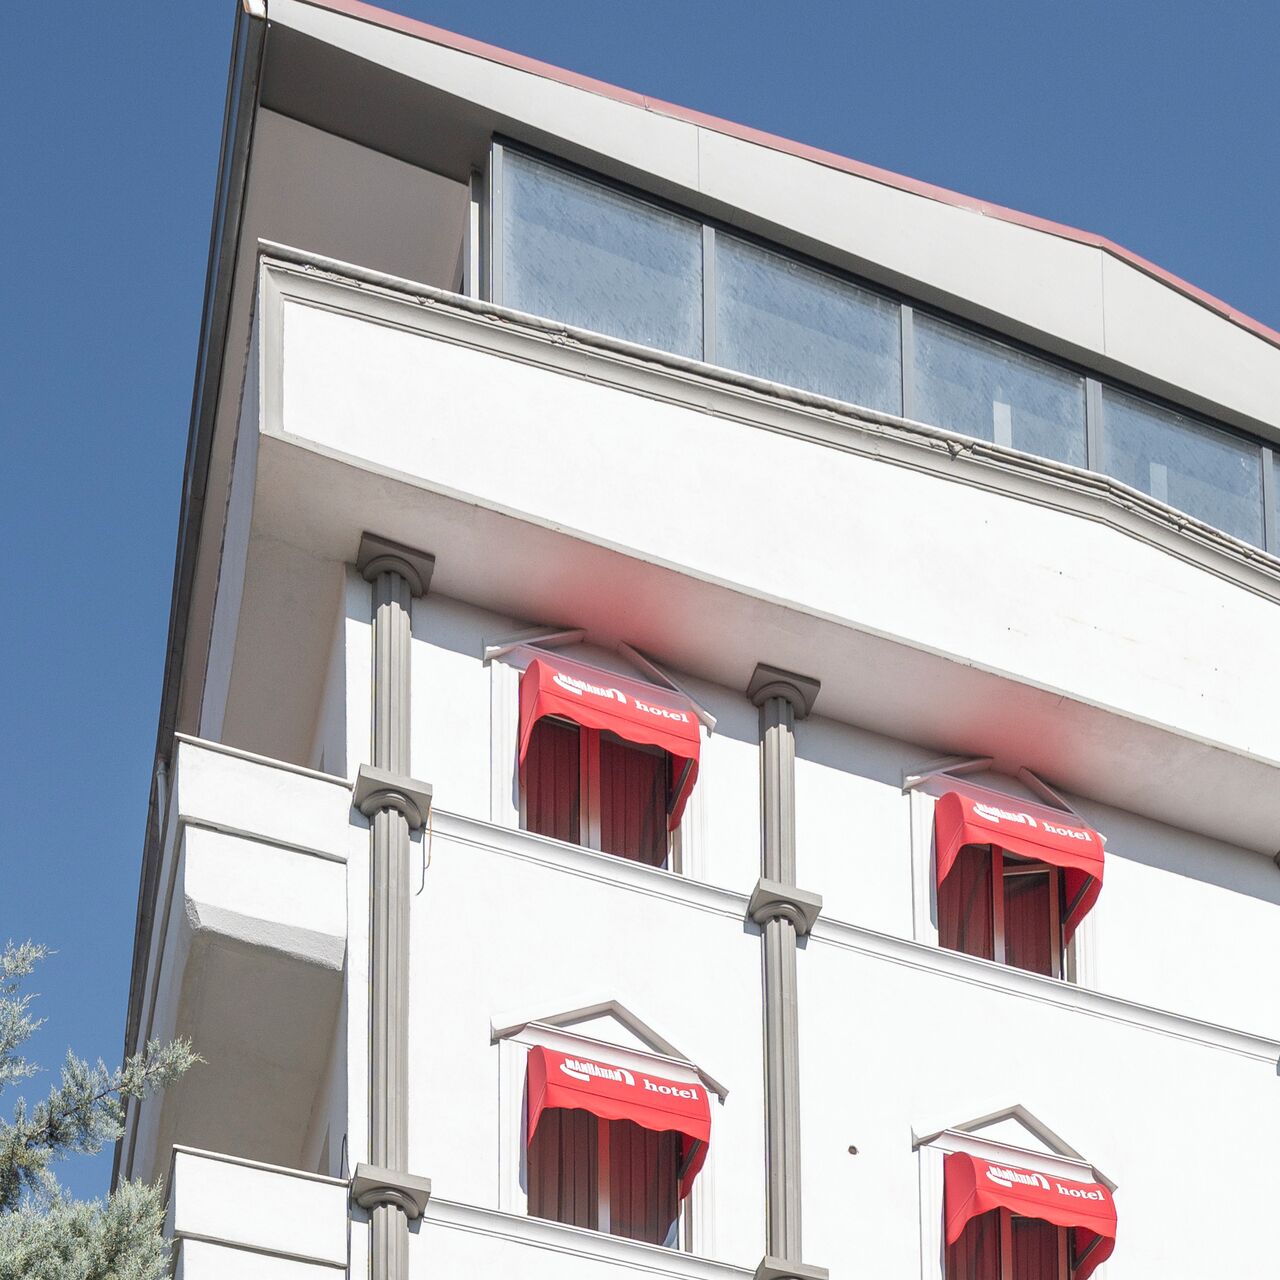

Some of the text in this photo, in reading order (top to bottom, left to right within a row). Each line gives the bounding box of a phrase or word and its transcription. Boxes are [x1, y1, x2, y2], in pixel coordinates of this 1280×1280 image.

[635, 699, 689, 723] hotel
[1042, 822, 1092, 841] hotel
[564, 1058, 699, 1100] MANHATTAN hotel
[1056, 1183, 1105, 1201] hotel
